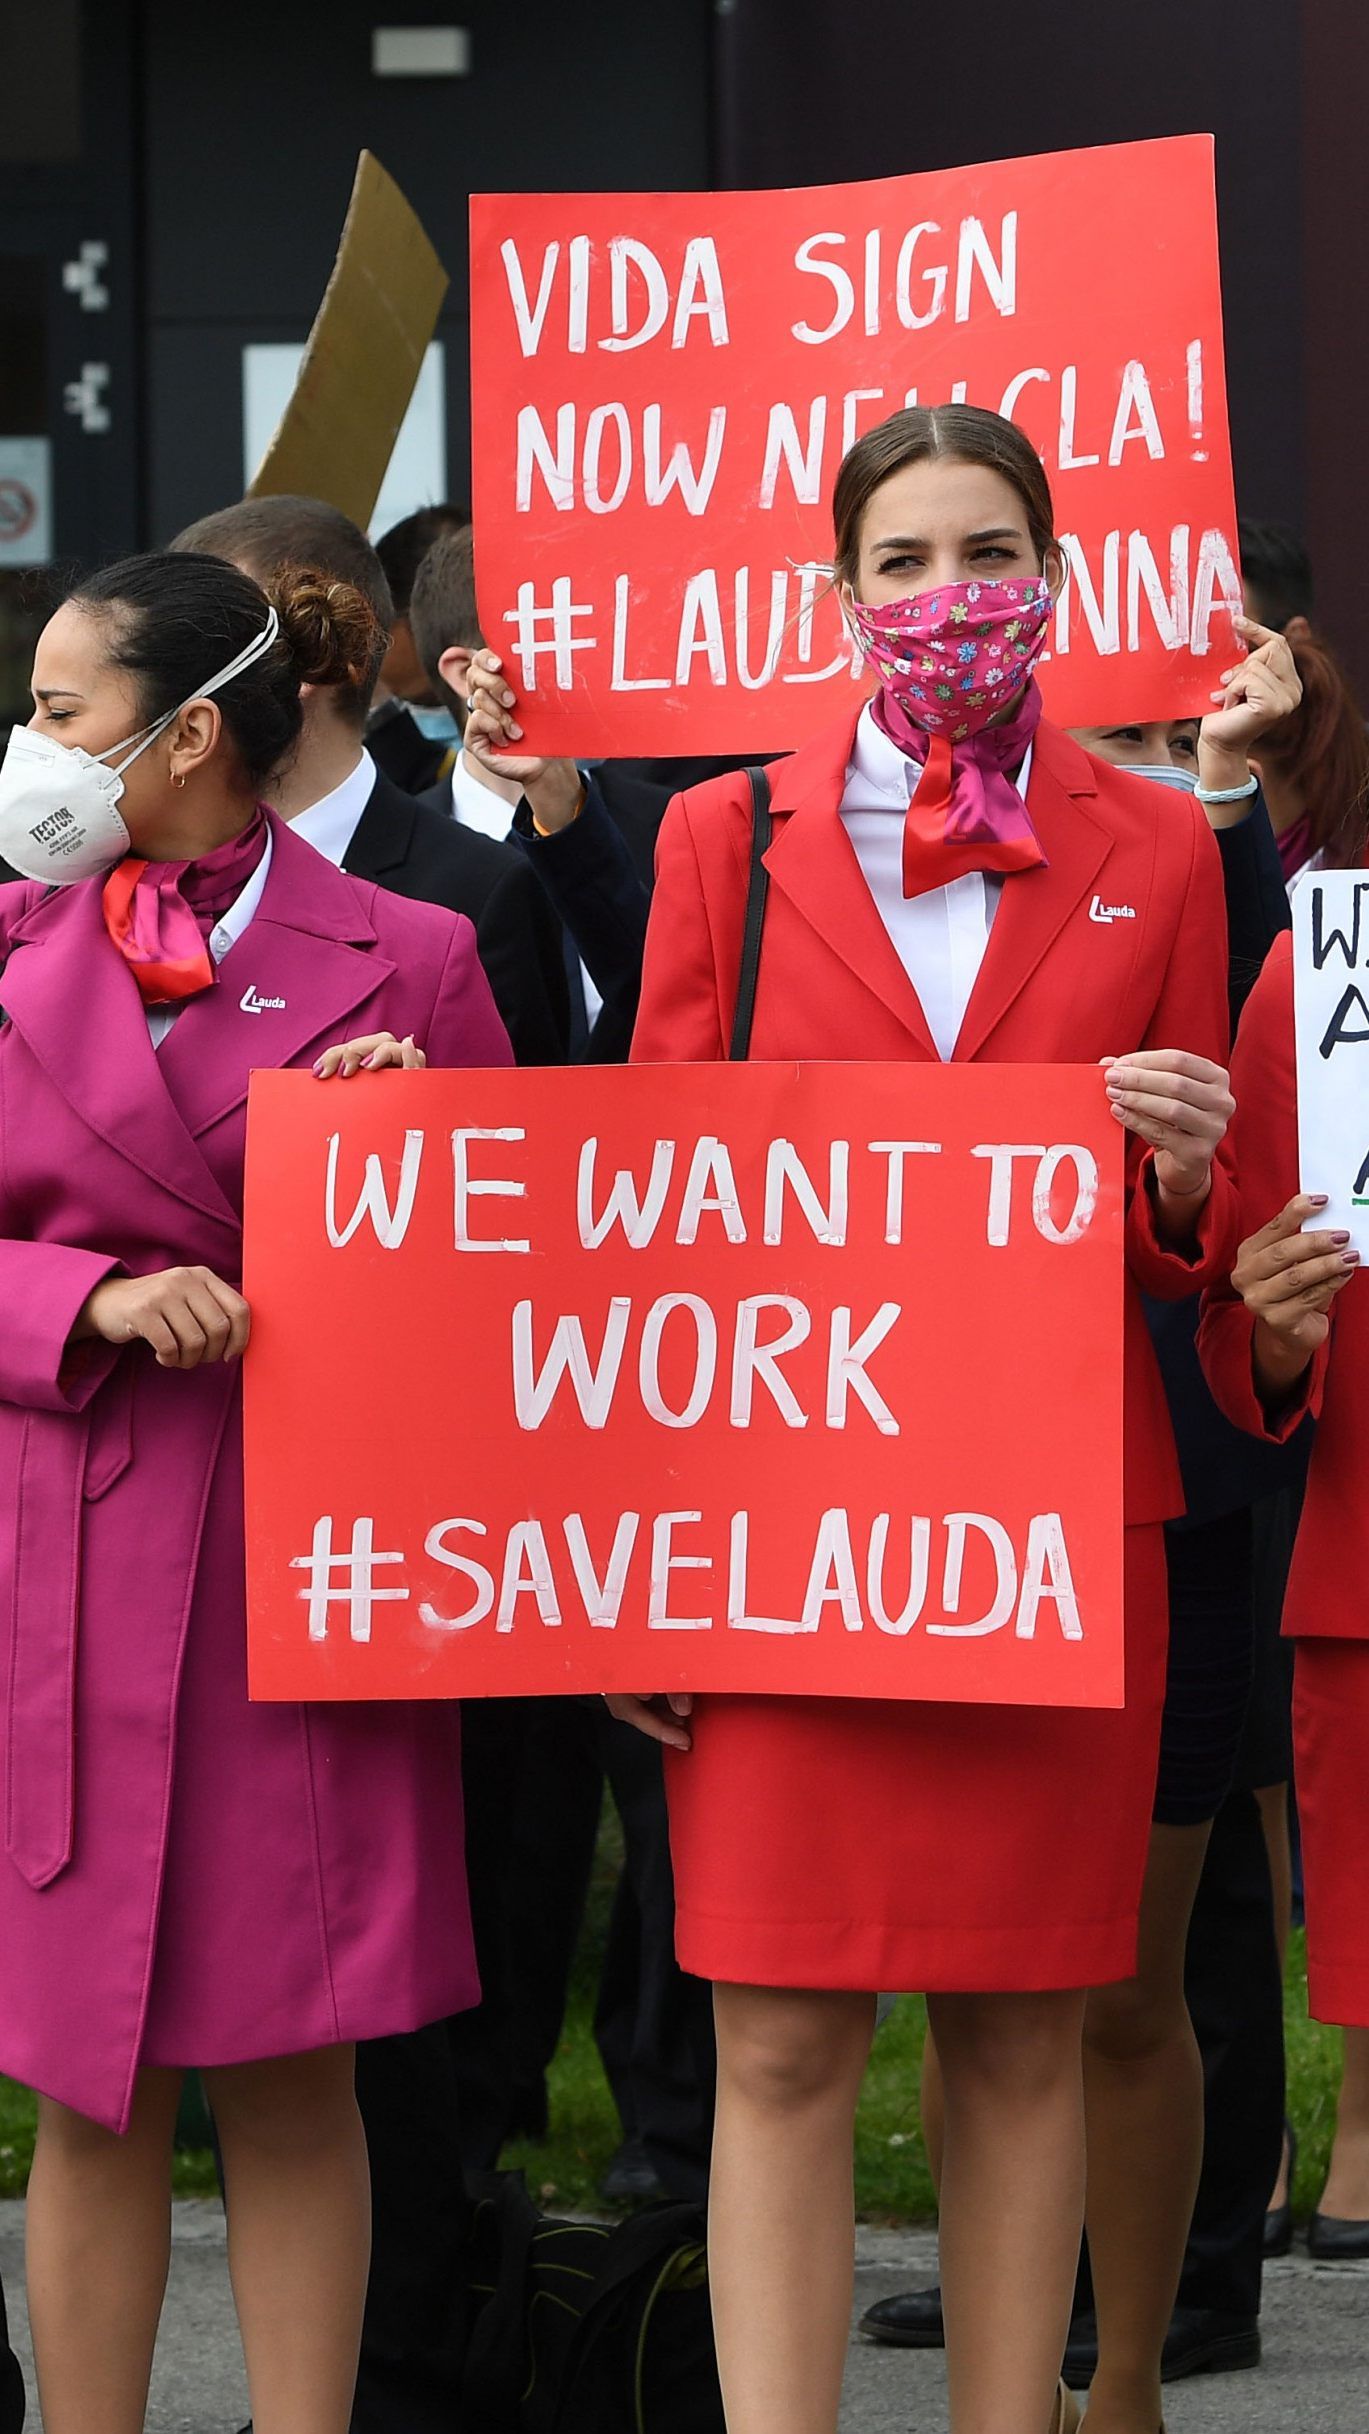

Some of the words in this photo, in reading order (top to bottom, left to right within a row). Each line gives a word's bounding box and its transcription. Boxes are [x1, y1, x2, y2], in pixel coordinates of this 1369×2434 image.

[500, 235, 730, 358] VIDA
[791, 210, 1018, 345] SIGN
[516, 401, 727, 516] NOW
[28, 805, 75, 844] TECTOR
[325, 1127, 531, 1253] WE
[577, 1136, 942, 1249] WANT
[970, 1143, 1101, 1247] TO
[512, 1292, 902, 1436] WORK
[288, 1507, 1084, 1643] #SAVELAUDA
